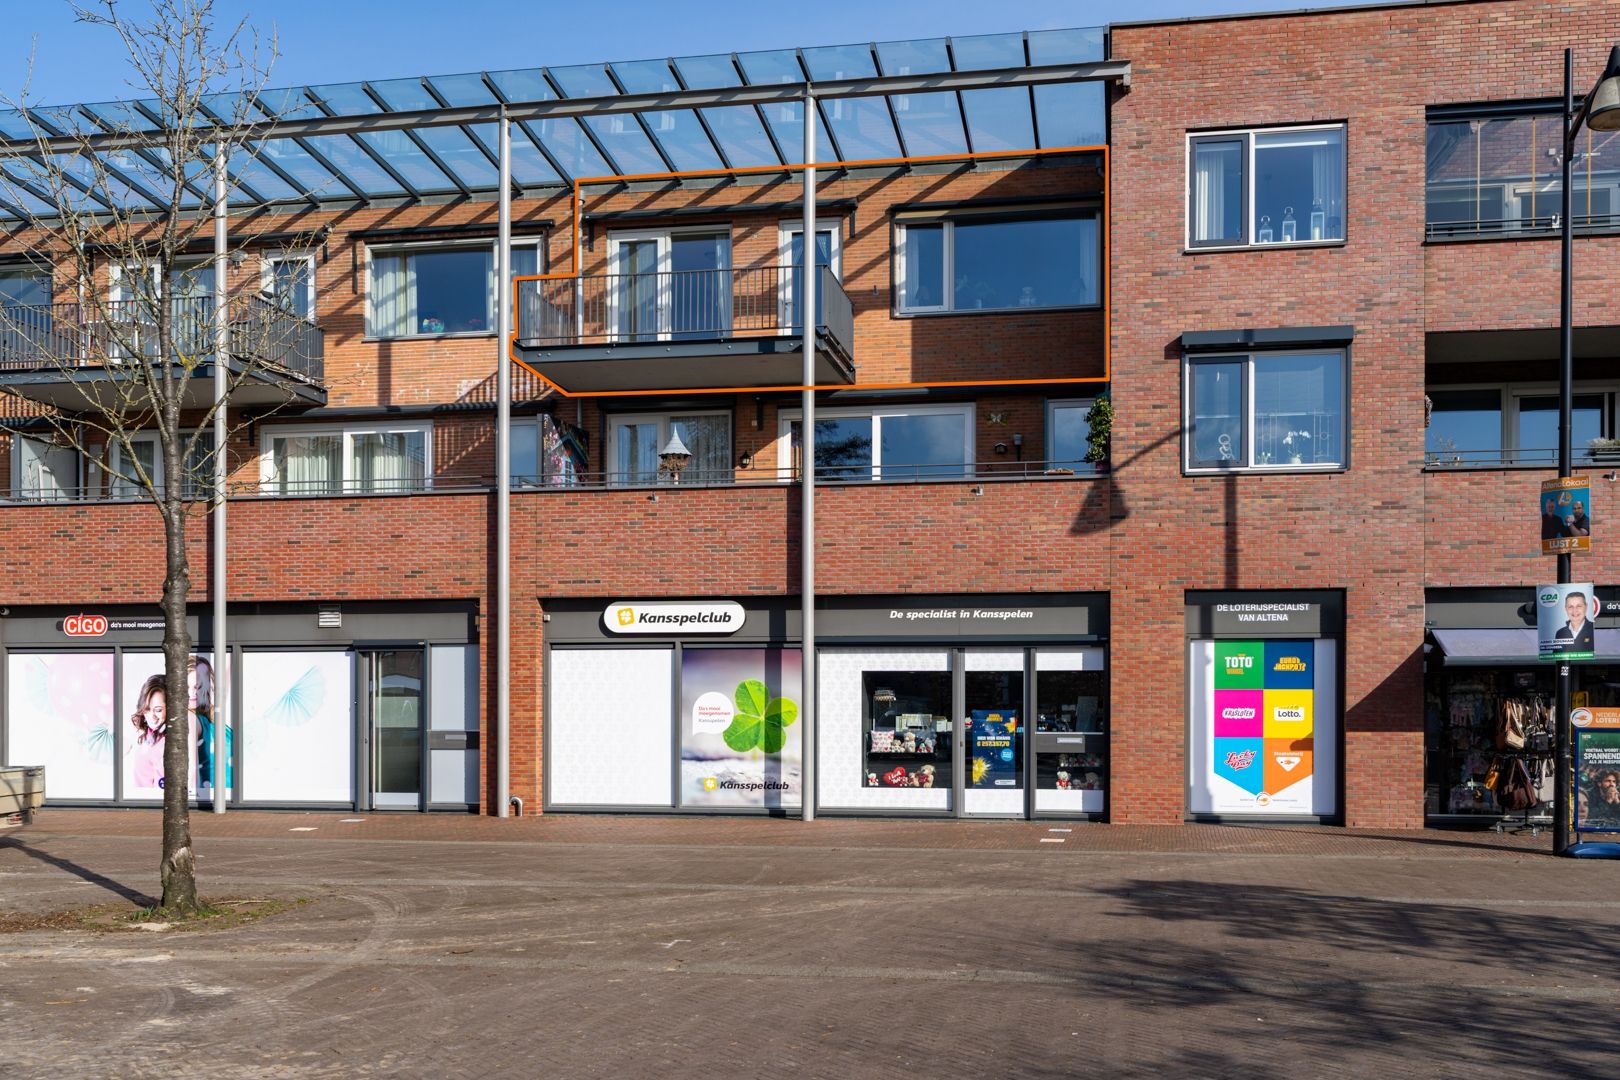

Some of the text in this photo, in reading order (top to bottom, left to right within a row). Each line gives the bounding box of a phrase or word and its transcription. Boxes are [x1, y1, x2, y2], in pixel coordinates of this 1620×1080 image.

[1571, 538, 1579, 547] 2
[1540, 593, 1558, 601] CDA
[1216, 603, 1310, 612] DE LOTERIJSPECIALIST
[638, 611, 732, 627] Kansspelclub
[889, 609, 1034, 621] De specialist in Kansspelen
[1238, 613, 1289, 622] VAN ALTENA
[66, 616, 105, 633] CIGO
[110, 621, 122, 629] da's
[137, 622, 166, 630] meegenom
[1224, 656, 1253, 668] TOTO
[1224, 709, 1254, 718] KRASLOTEN
[1225, 750, 1256, 764] Lucky
[1231, 760, 1252, 771] Day
[719, 780, 790, 792] Kansspelclub
